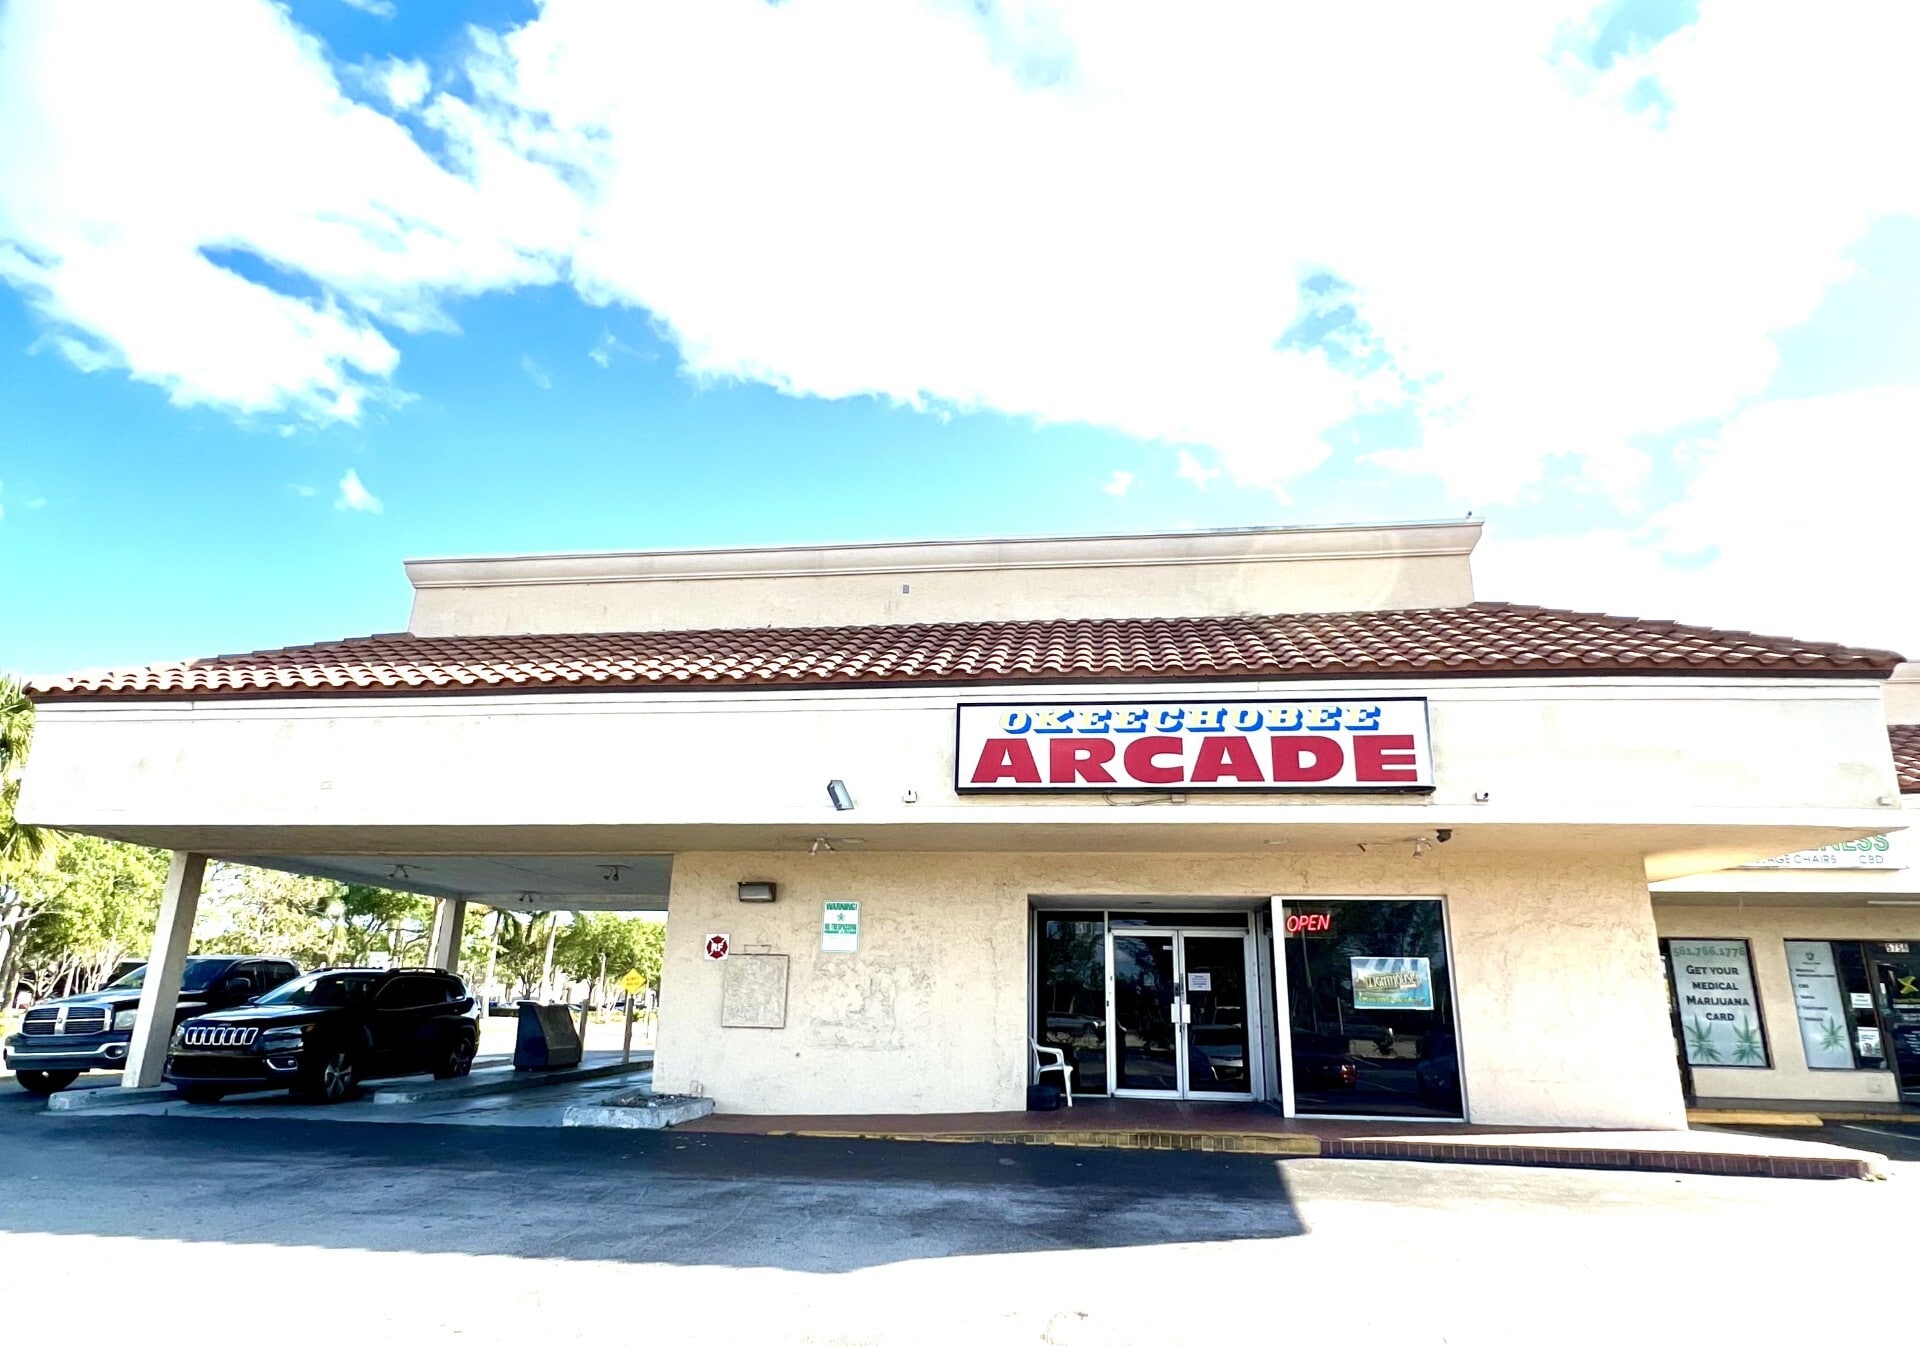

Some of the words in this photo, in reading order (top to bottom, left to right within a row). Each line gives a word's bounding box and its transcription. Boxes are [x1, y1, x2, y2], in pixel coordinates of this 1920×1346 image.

[1000, 706, 1381, 734] OKEECHOBEE
[970, 735, 1418, 784] ARCADE
[1794, 855, 1837, 864] CHAIRS
[1859, 855, 1883, 864] CBD
[1286, 914, 1330, 932] OPEN
[1686, 965, 1707, 975] GET
[1709, 966, 1739, 975] YOUR
[1692, 982, 1739, 990] MEDICAL
[1686, 995, 1750, 1006] MARIJUANA
[1706, 1012, 1735, 1022] CARD
